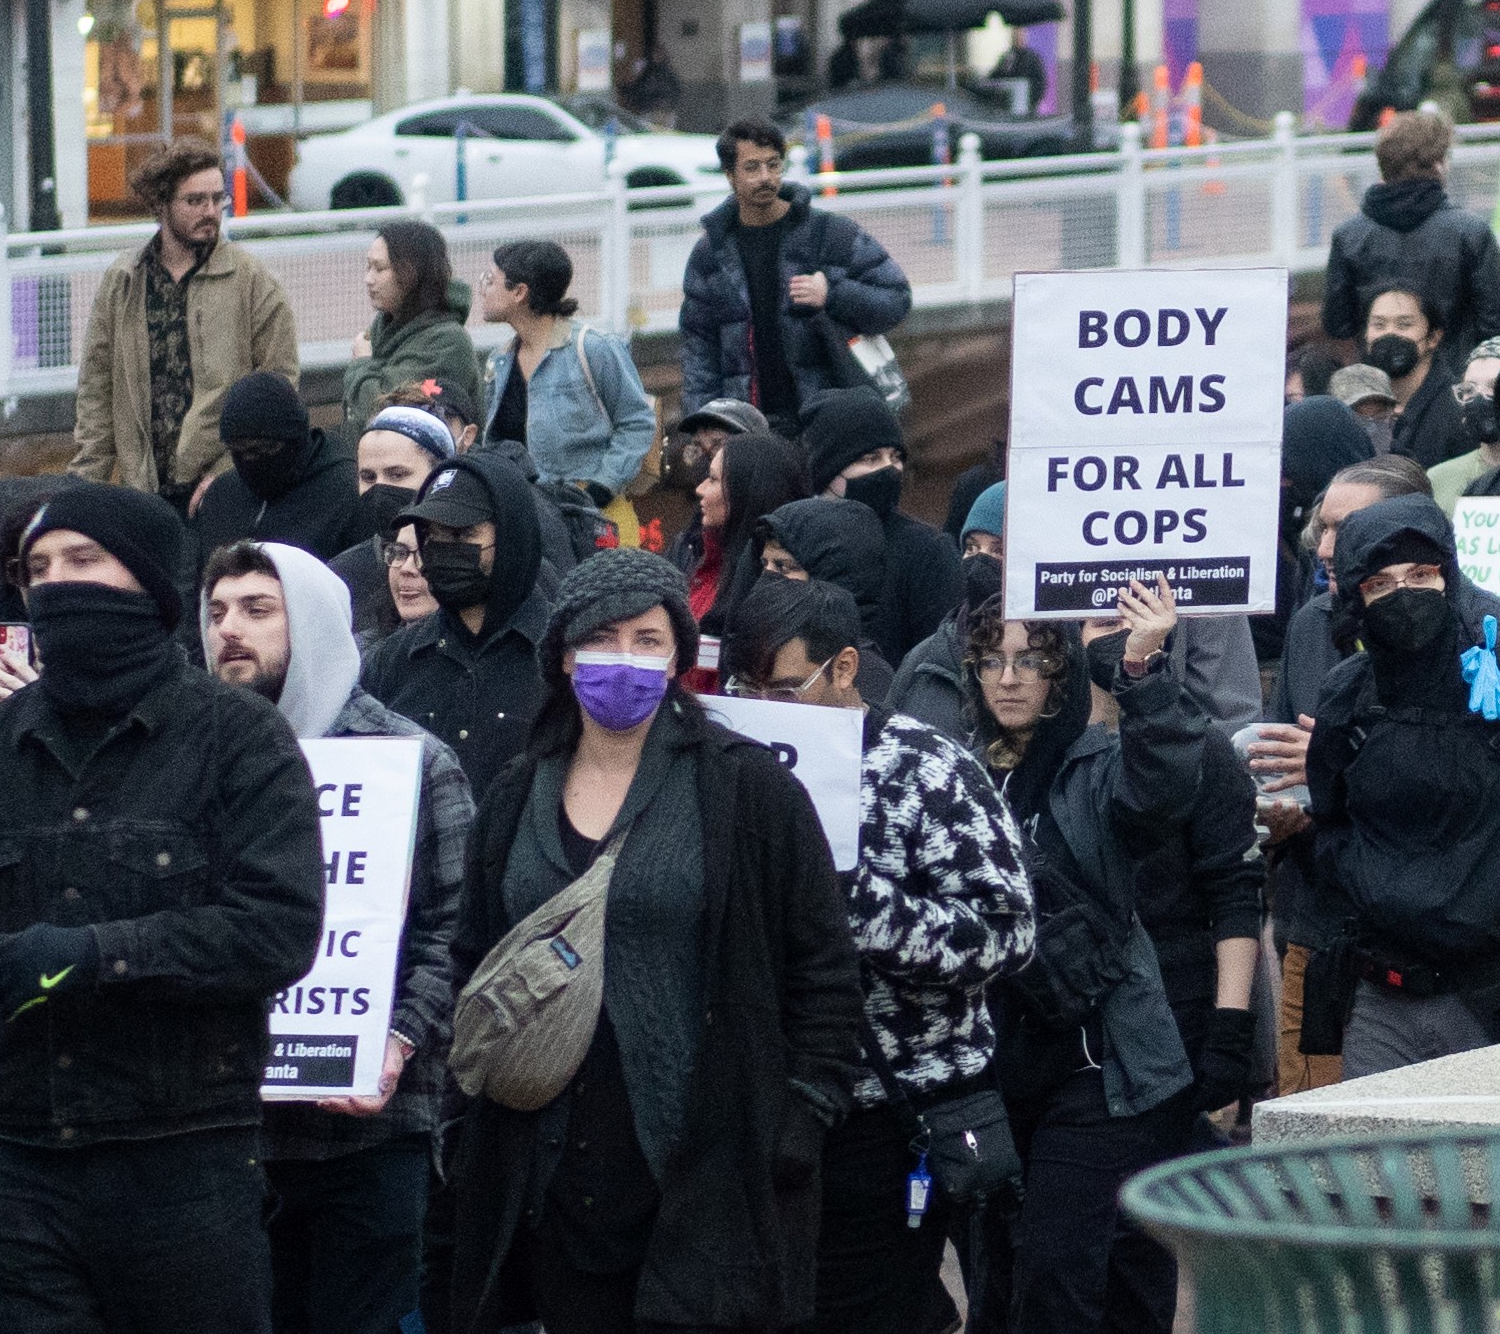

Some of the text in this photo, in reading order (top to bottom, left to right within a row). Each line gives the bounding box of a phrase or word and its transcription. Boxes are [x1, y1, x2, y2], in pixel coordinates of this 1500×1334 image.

[1078, 307, 1229, 349] BODY
[1073, 374, 1227, 416] CAMS
[1047, 452, 1246, 492] FOR ALL
[1081, 508, 1208, 546] COPS
[1462, 510, 1500, 529] YOU
[1457, 535, 1481, 555] AS
[1040, 565, 1245, 586] Party for Socialism & Liberation
[287, 1042, 352, 1059] Liberation
